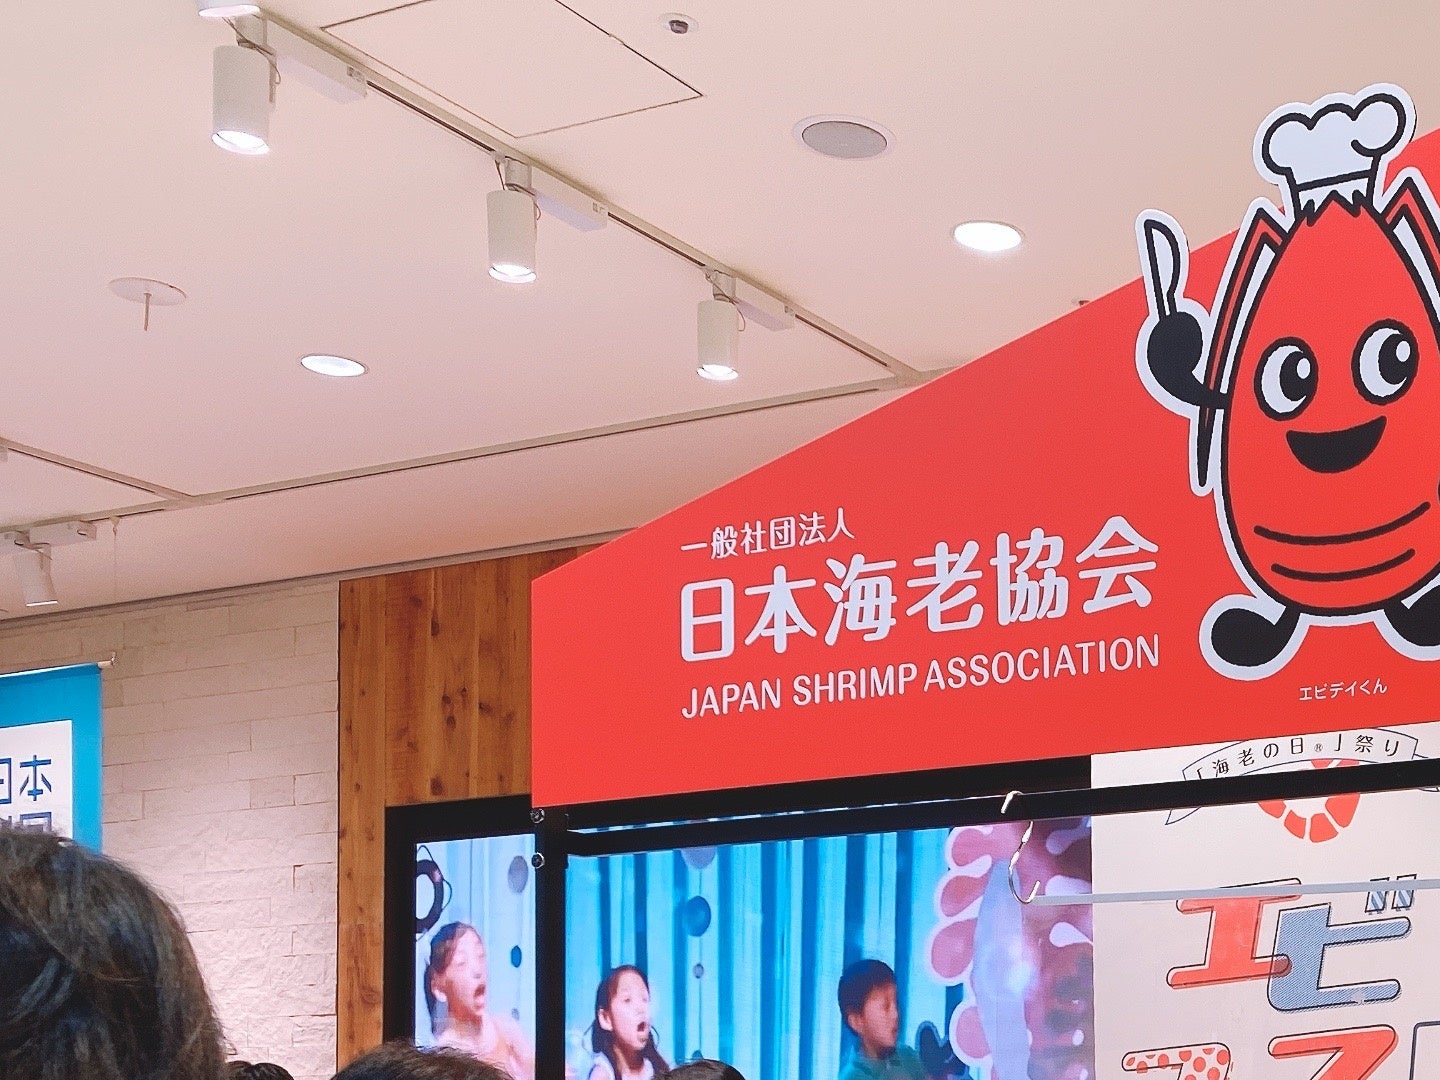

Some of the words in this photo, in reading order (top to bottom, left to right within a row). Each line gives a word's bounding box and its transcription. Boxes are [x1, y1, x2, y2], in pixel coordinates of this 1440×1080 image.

[680, 507, 855, 559] 一般社団法人
[680, 515, 1159, 662] 日本海老協会
[681, 678, 781, 719] JAPAN
[792, 661, 919, 706] SHRIMP
[923, 633, 1160, 692] ASSOCIATION
[1166, 874, 1417, 1012] エビ
